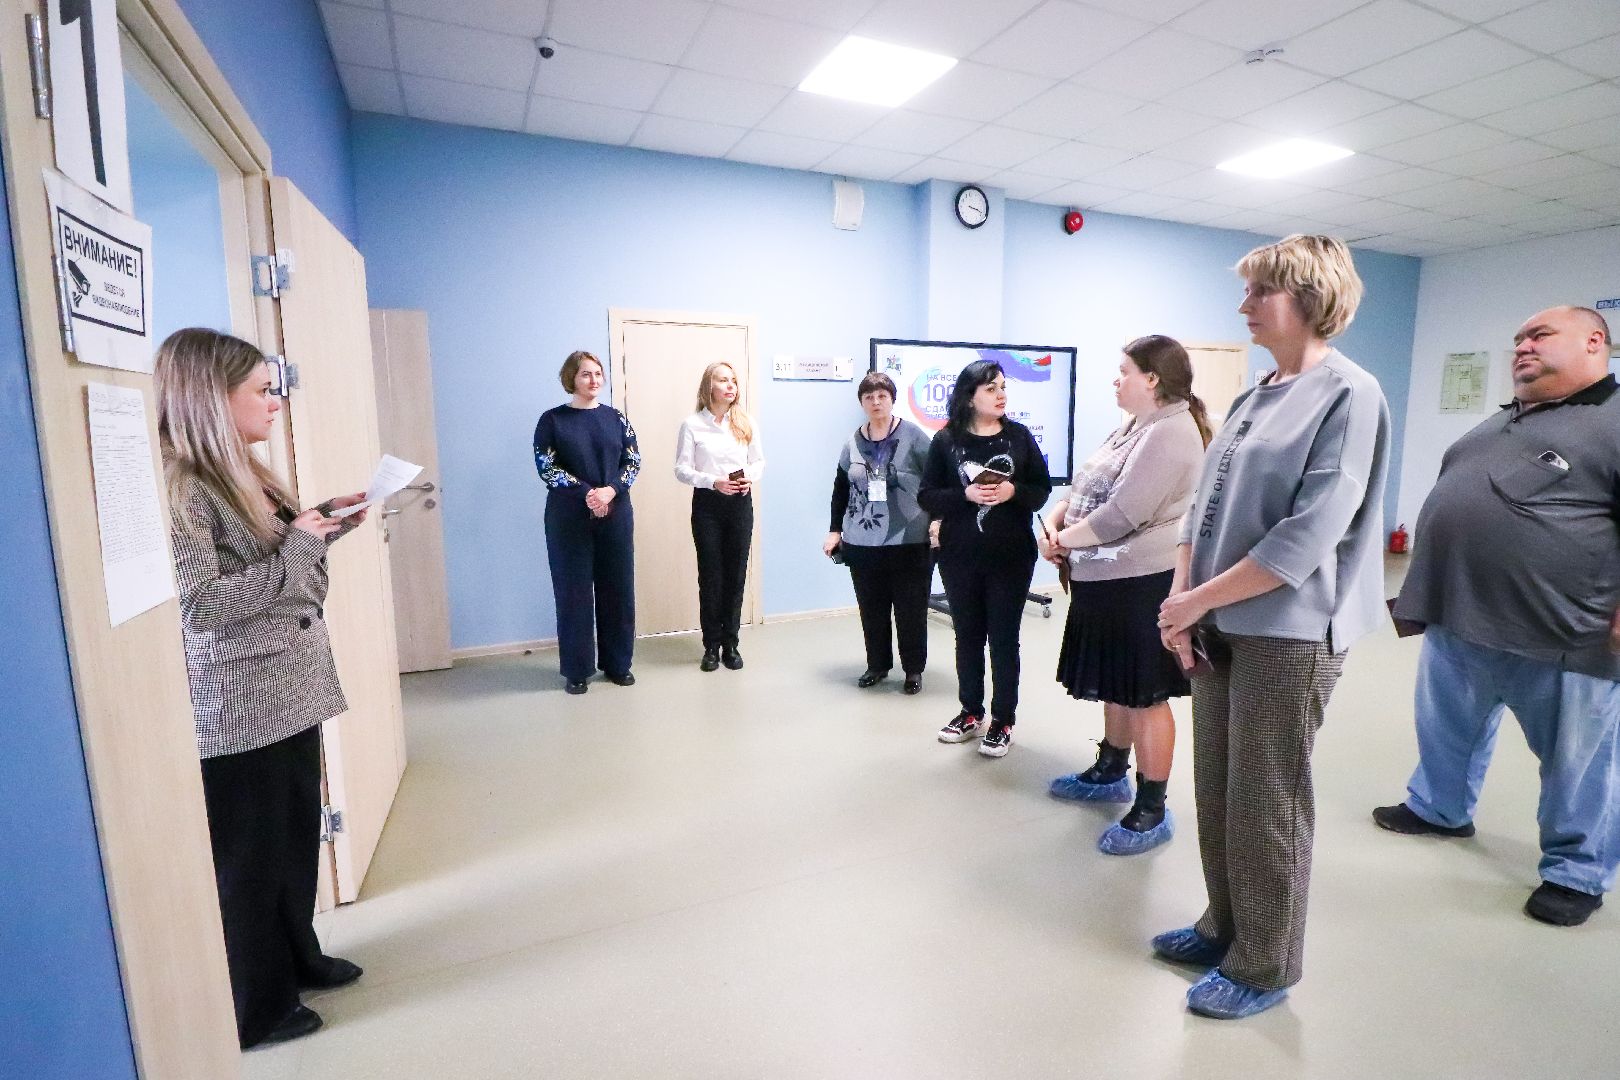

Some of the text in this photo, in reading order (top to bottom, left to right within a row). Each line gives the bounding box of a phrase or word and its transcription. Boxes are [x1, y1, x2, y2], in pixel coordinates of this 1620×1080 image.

[59, 0, 107, 187] 1
[63, 224, 138, 278] ВНИМАНИЕ!
[1200, 495, 1220, 538] STATE
[1213, 472, 1225, 492] OF
